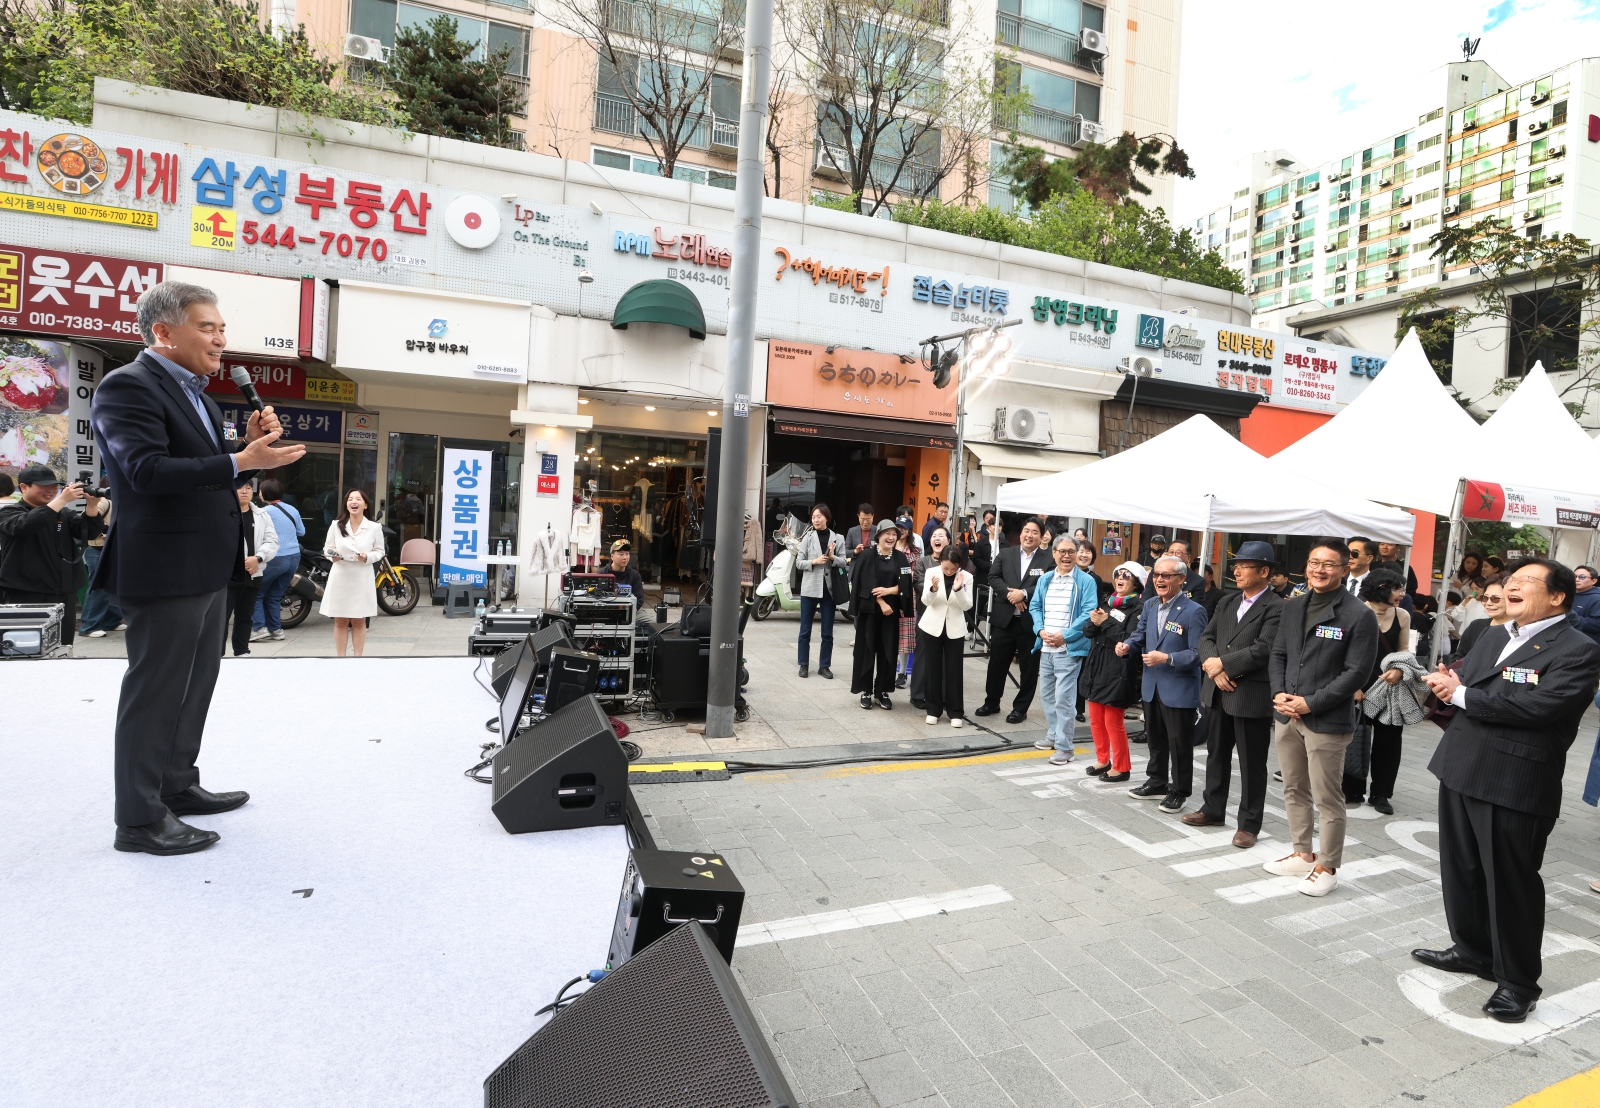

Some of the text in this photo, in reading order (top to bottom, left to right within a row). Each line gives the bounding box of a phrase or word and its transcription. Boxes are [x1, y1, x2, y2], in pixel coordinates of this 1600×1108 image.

[114, 146, 179, 205] 가게
[73, 206, 128, 221] 010-7756-7707
[131, 212, 154, 227] 122호
[535, 211, 550, 222] Bar
[241, 220, 388, 261] 544-7070
[513, 230, 589, 251] On The Ground
[652, 226, 731, 269] 노래연습
[29, 256, 157, 313] 옷수선
[679, 269, 731, 288] 3443-401
[29, 311, 141, 336] 010-7383-456
[1031, 295, 1118, 334] 삼영크리닝
[264, 336, 294, 349] 143호
[405, 339, 469, 355] 압구정 바우처
[1218, 330, 1275, 359] 현대부동산
[819, 361, 921, 387] うちのカレー
[1283, 352, 1338, 375] 로데오 명품사
[307, 380, 340, 394] 이윤송
[1216, 371, 1273, 395] 전자담배
[544, 459, 554, 469] 28
[450, 458, 483, 560] 상품권
